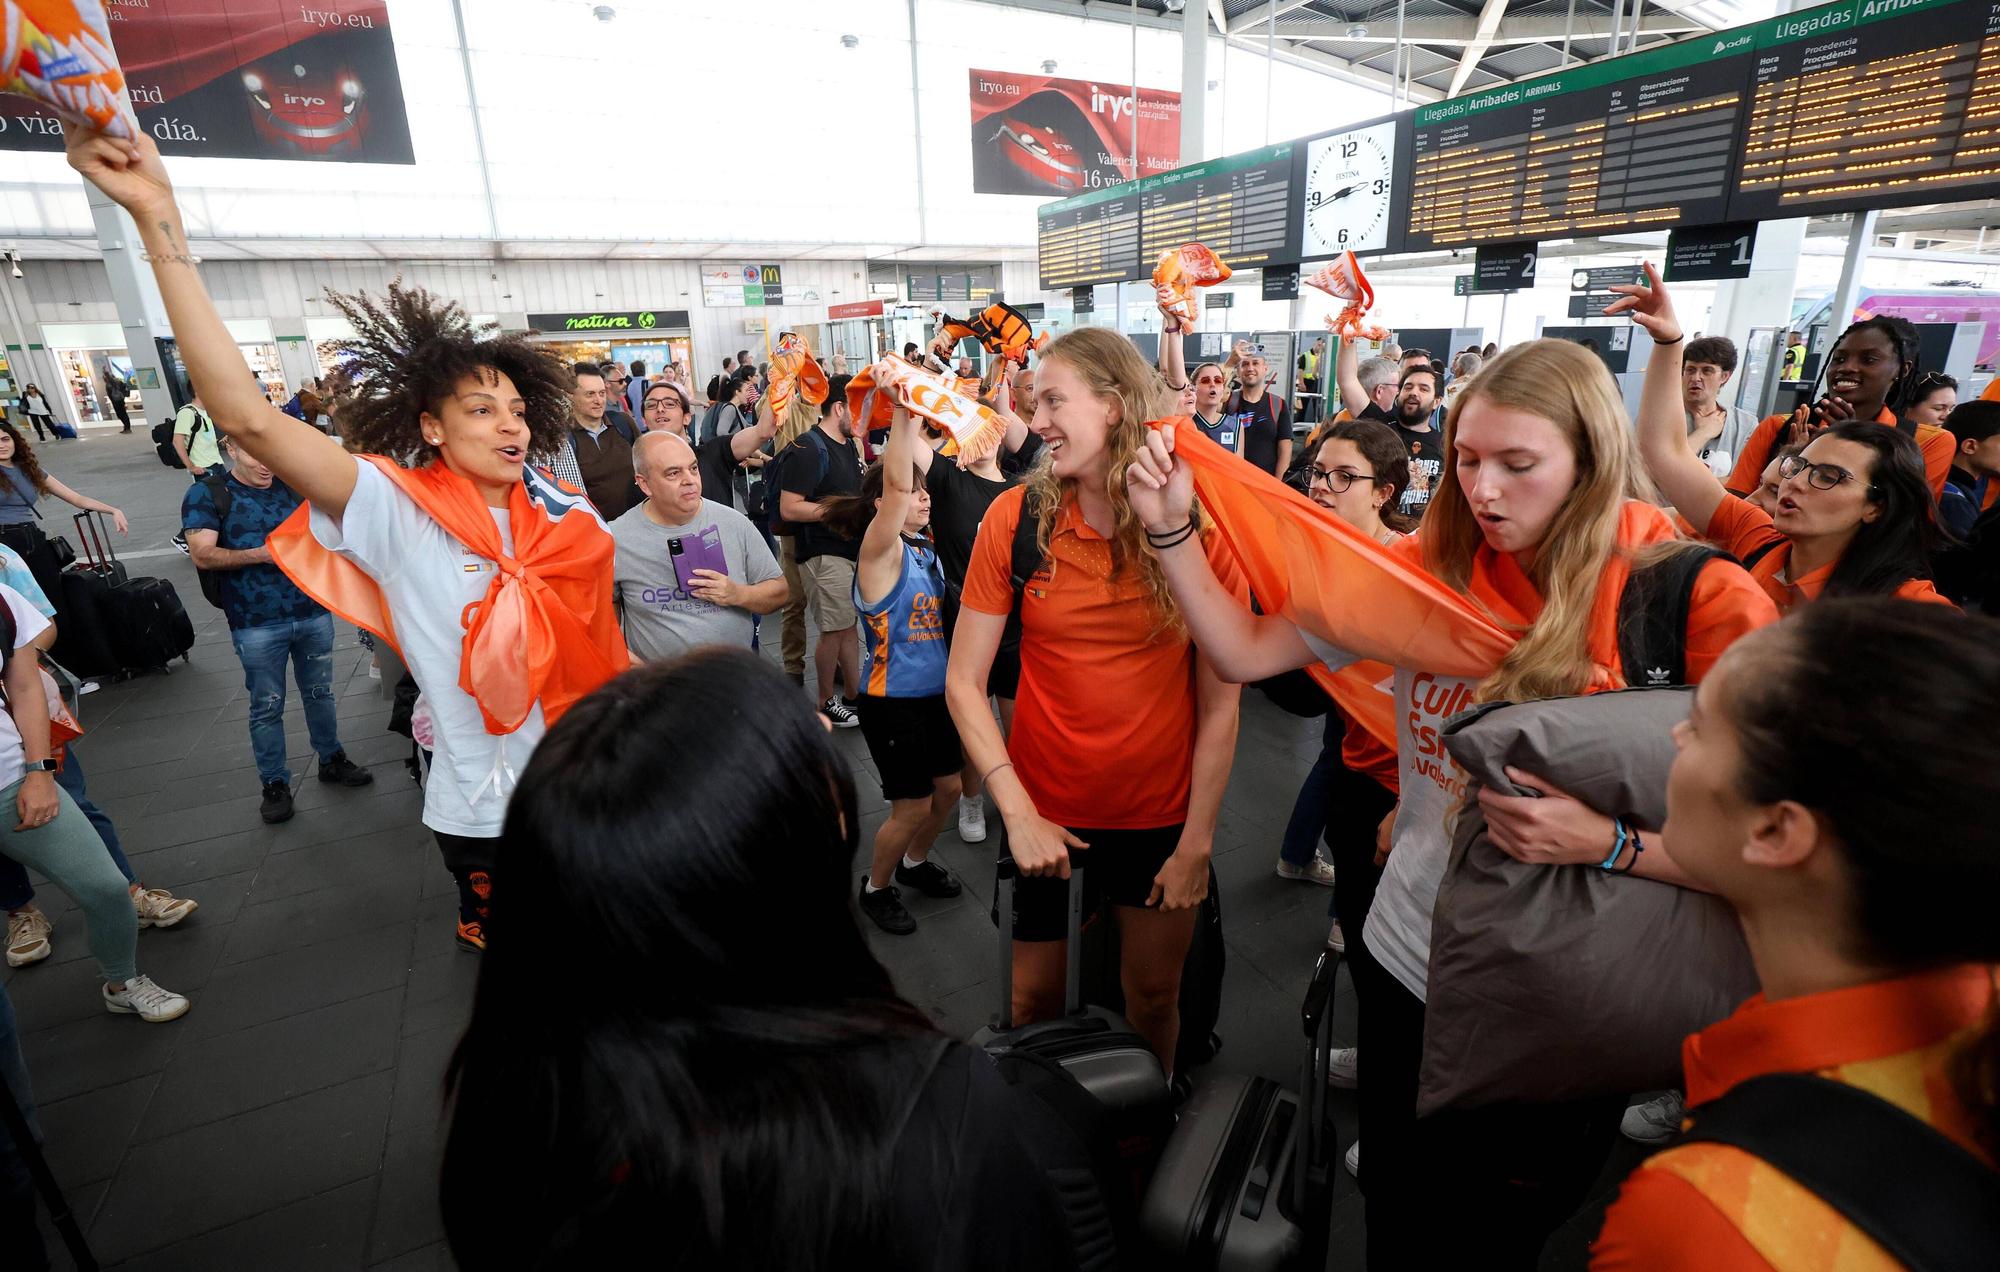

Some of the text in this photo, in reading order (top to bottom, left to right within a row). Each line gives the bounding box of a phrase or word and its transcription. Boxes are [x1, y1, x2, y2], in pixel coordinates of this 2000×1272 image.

[300, 5, 373, 29] iryo.eu
[1776, 9, 1851, 39] Llegadas
[1805, 37, 1858, 56] Procedencia
[1759, 55, 1780, 66] Hora
[1803, 47, 1858, 66] Procedència
[1757, 66, 1778, 76] Hora
[979, 79, 1020, 96] iryo.eu
[1639, 76, 1690, 92] Observaciones
[130, 85, 164, 104] rid
[283, 93, 326, 107] iryo
[1424, 82, 1561, 121] Llegadas Arribades ARRIVALS
[16, 111, 65, 135] via
[153, 117, 207, 141] día.
[1341, 141, 1358, 158] 12
[1146, 157, 1179, 171] Madrid
[1082, 169, 1101, 189] 16
[1336, 170, 1360, 181] FESTINA
[1373, 180, 1384, 195] 3
[1311, 191, 1321, 206] 9
[1338, 228, 1349, 243] 6
[1731, 236, 1750, 265] 1
[1521, 253, 1536, 278] 2
[1290, 272, 1299, 291] 3
[566, 316, 632, 330] natura
